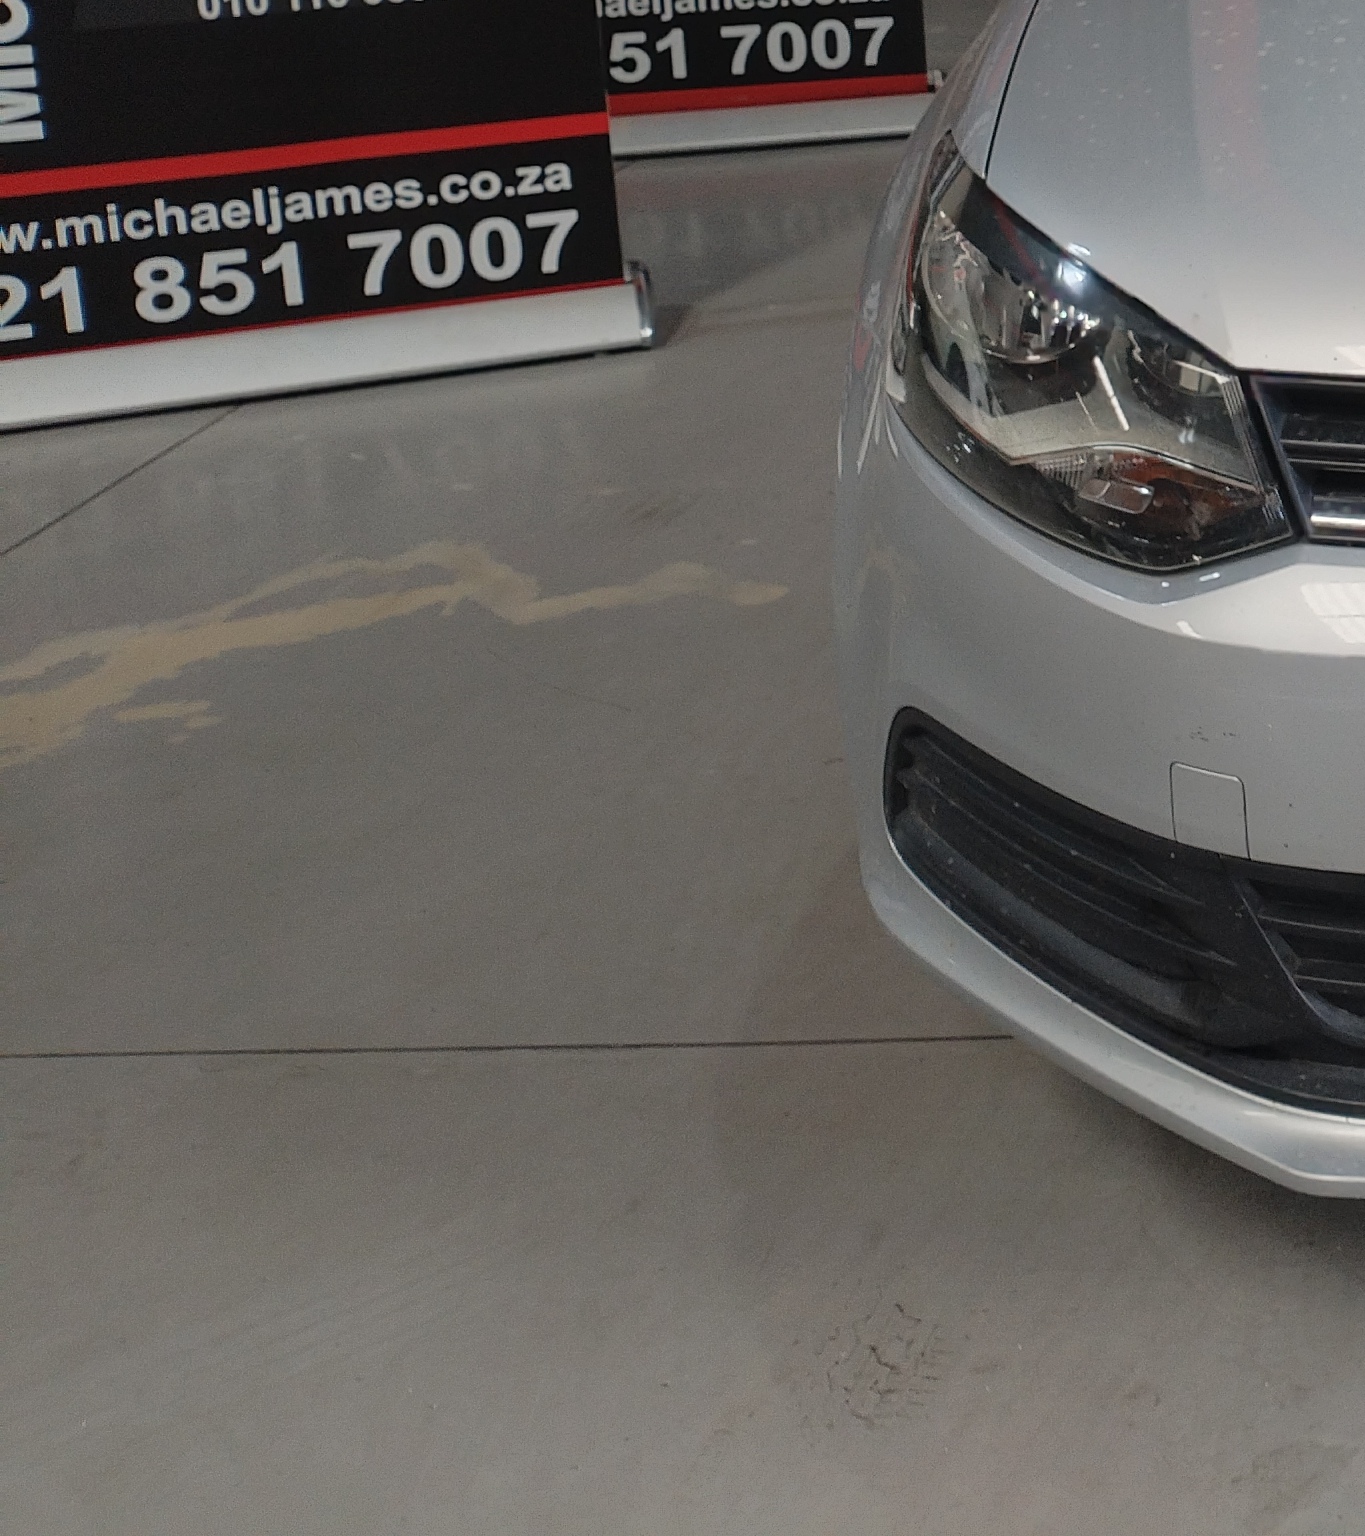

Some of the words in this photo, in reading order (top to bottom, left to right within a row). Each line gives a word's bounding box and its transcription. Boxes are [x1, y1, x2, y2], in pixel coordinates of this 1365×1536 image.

[608, 27, 688, 85] 51
[720, 16, 895, 76] 7007
[133, 242, 306, 324] 851
[347, 208, 581, 297] 7007
